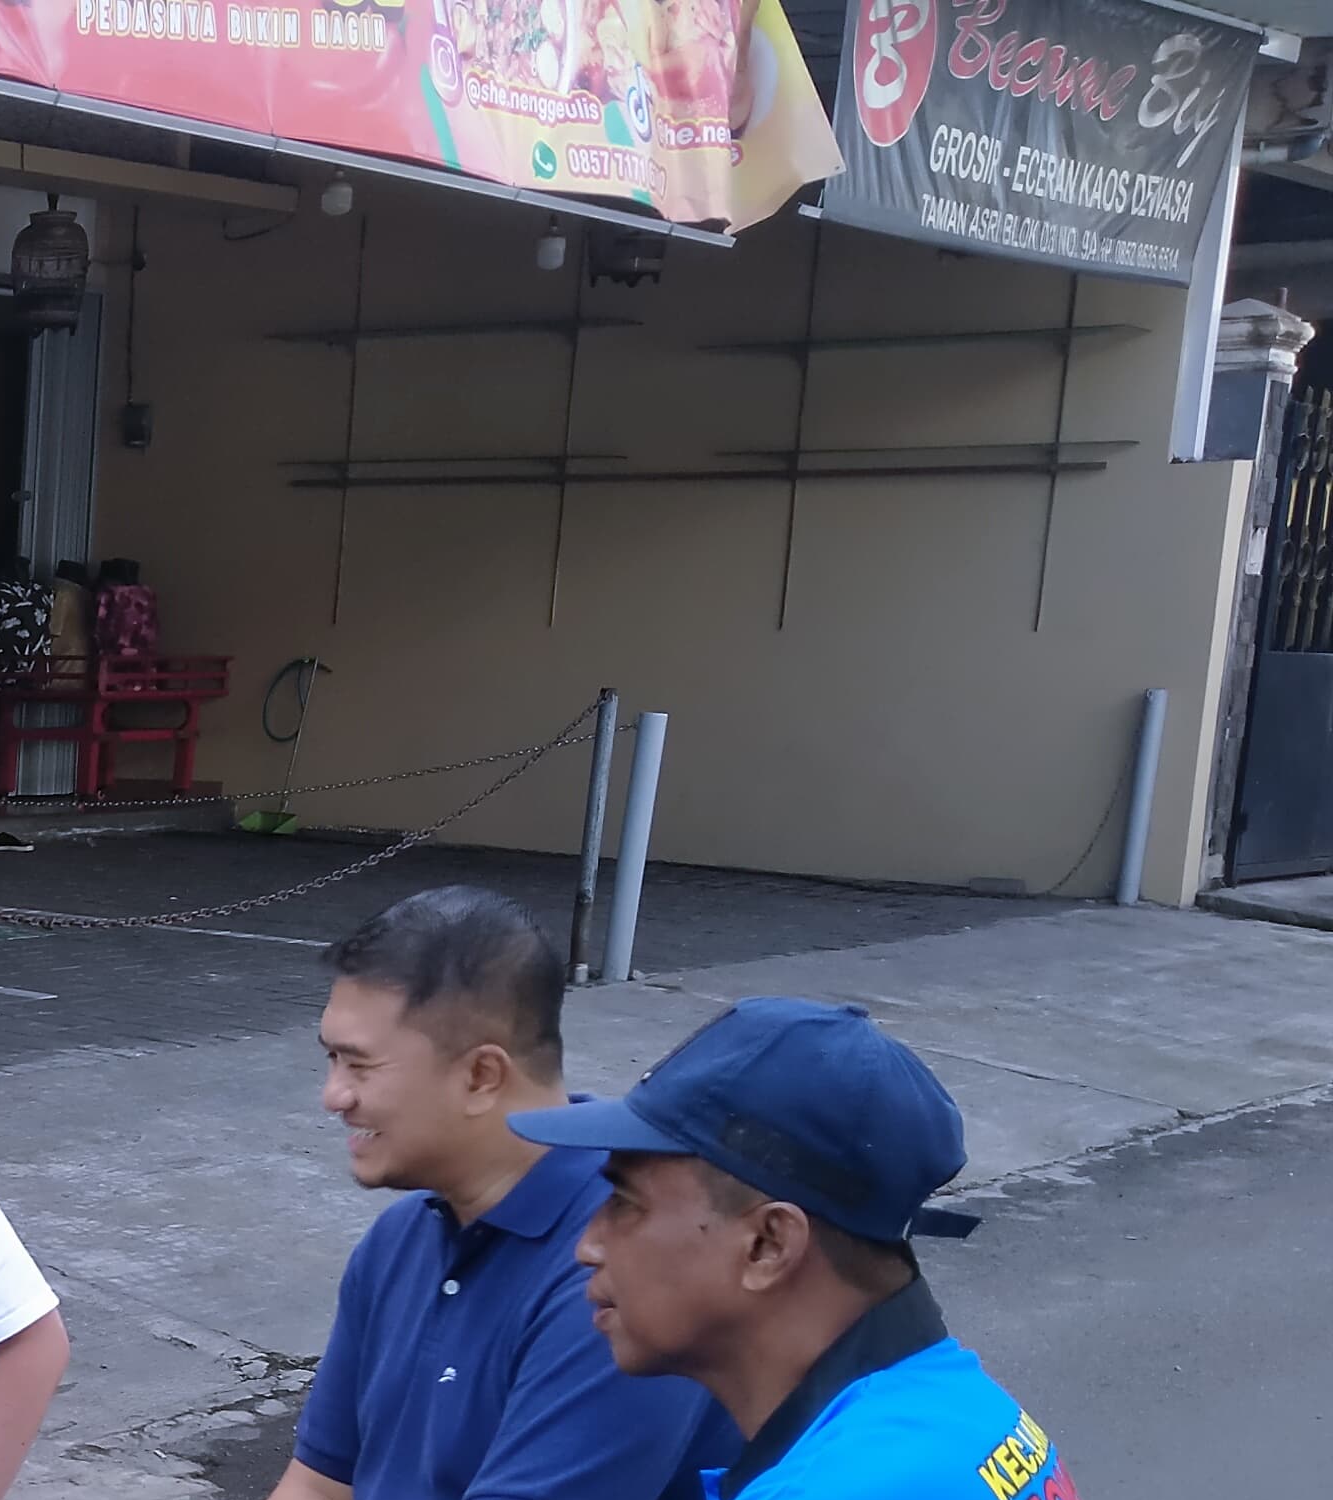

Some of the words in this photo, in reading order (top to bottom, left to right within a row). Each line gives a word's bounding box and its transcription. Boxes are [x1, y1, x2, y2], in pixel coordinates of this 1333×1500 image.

[79, 0, 216, 40] PEDASNYA
[229, 8, 300, 45] BIKIN
[569, 147, 611, 177] 0857
[929, 124, 1002, 185] GROSIR
[1012, 146, 1081, 205] ECERAN
[1078, 162, 1130, 214] KAOS
[1130, 173, 1195, 224] DEWASA
[920, 193, 970, 236] TAMAN
[968, 206, 1002, 244] ASRI
[1002, 213, 1041, 250] BLOK
